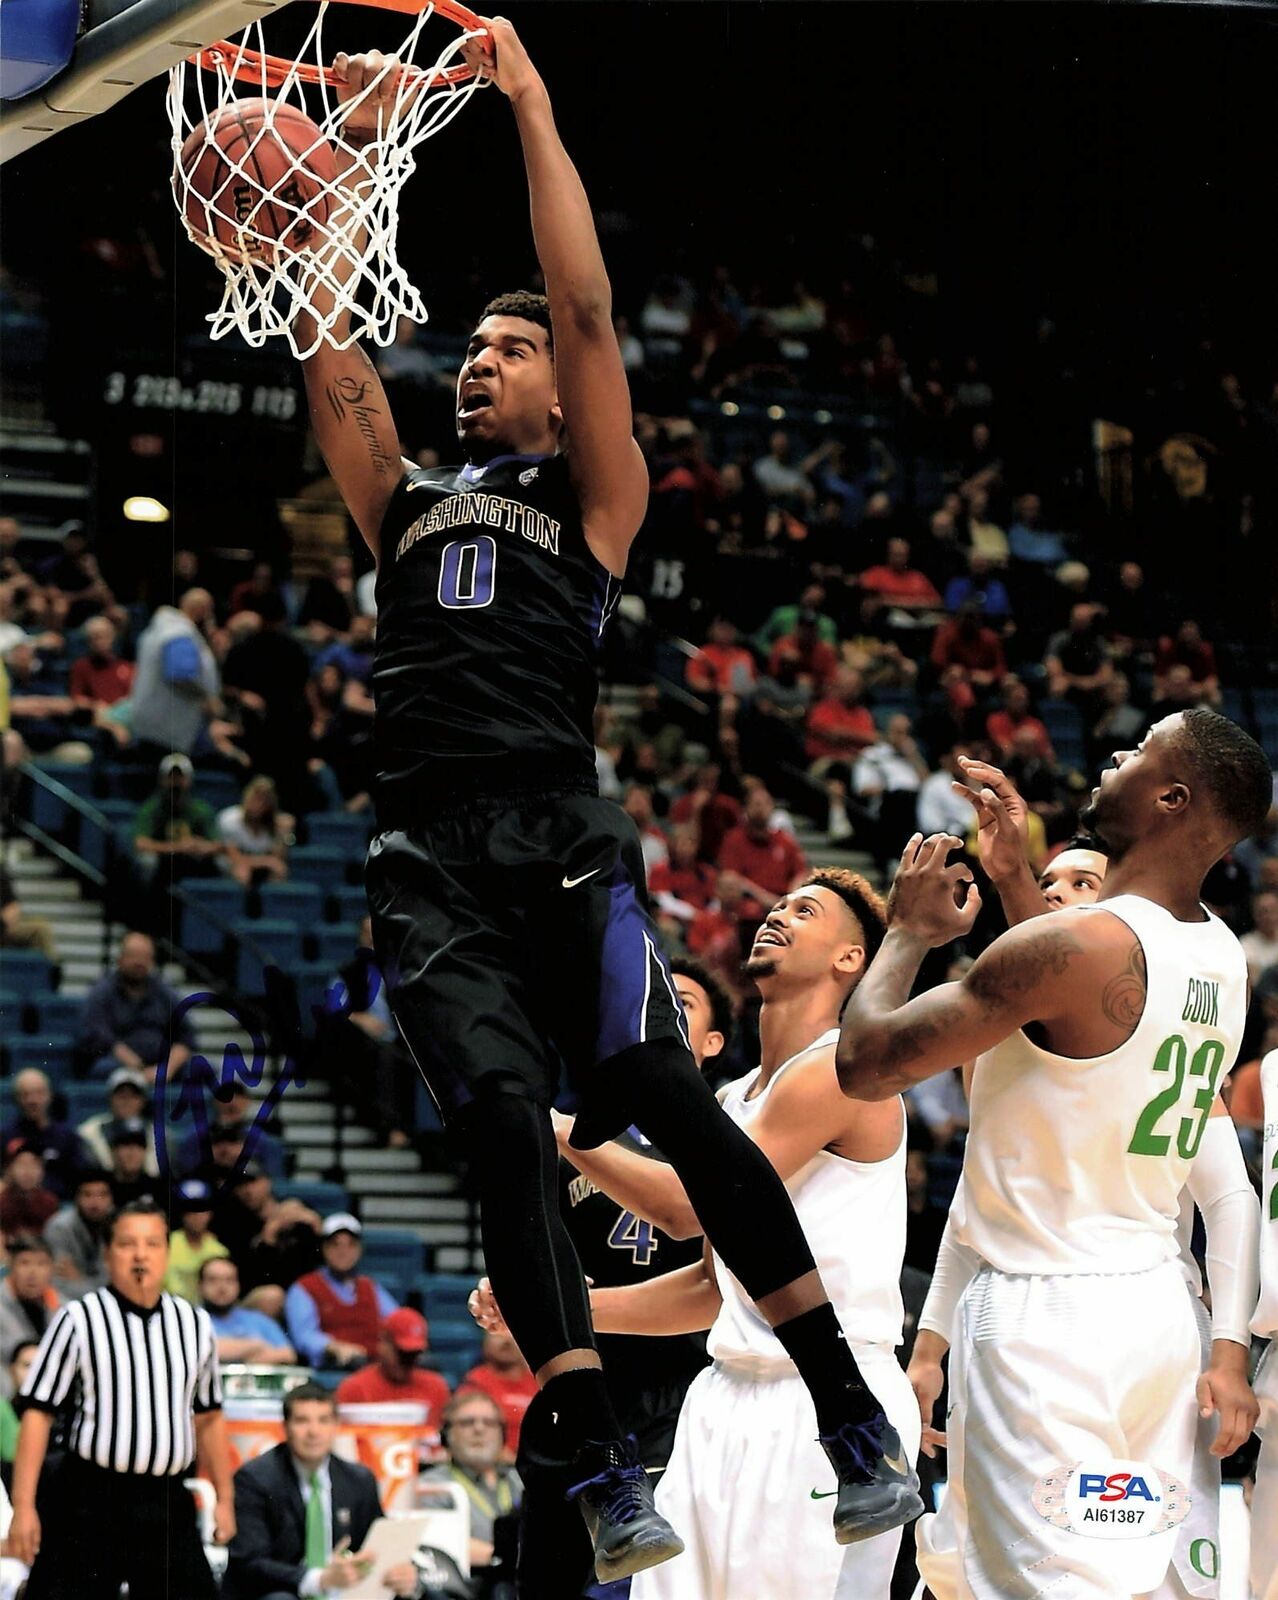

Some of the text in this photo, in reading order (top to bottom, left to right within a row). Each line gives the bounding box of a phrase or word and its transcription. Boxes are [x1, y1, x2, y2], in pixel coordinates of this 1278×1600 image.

[395, 492, 561, 563] WASHINGTON
[437, 535, 497, 609] 0
[1182, 978, 1219, 1027] COOK
[1127, 1033, 1226, 1160] 23
[607, 1209, 658, 1265] 4
[381, 1443, 413, 1478] G
